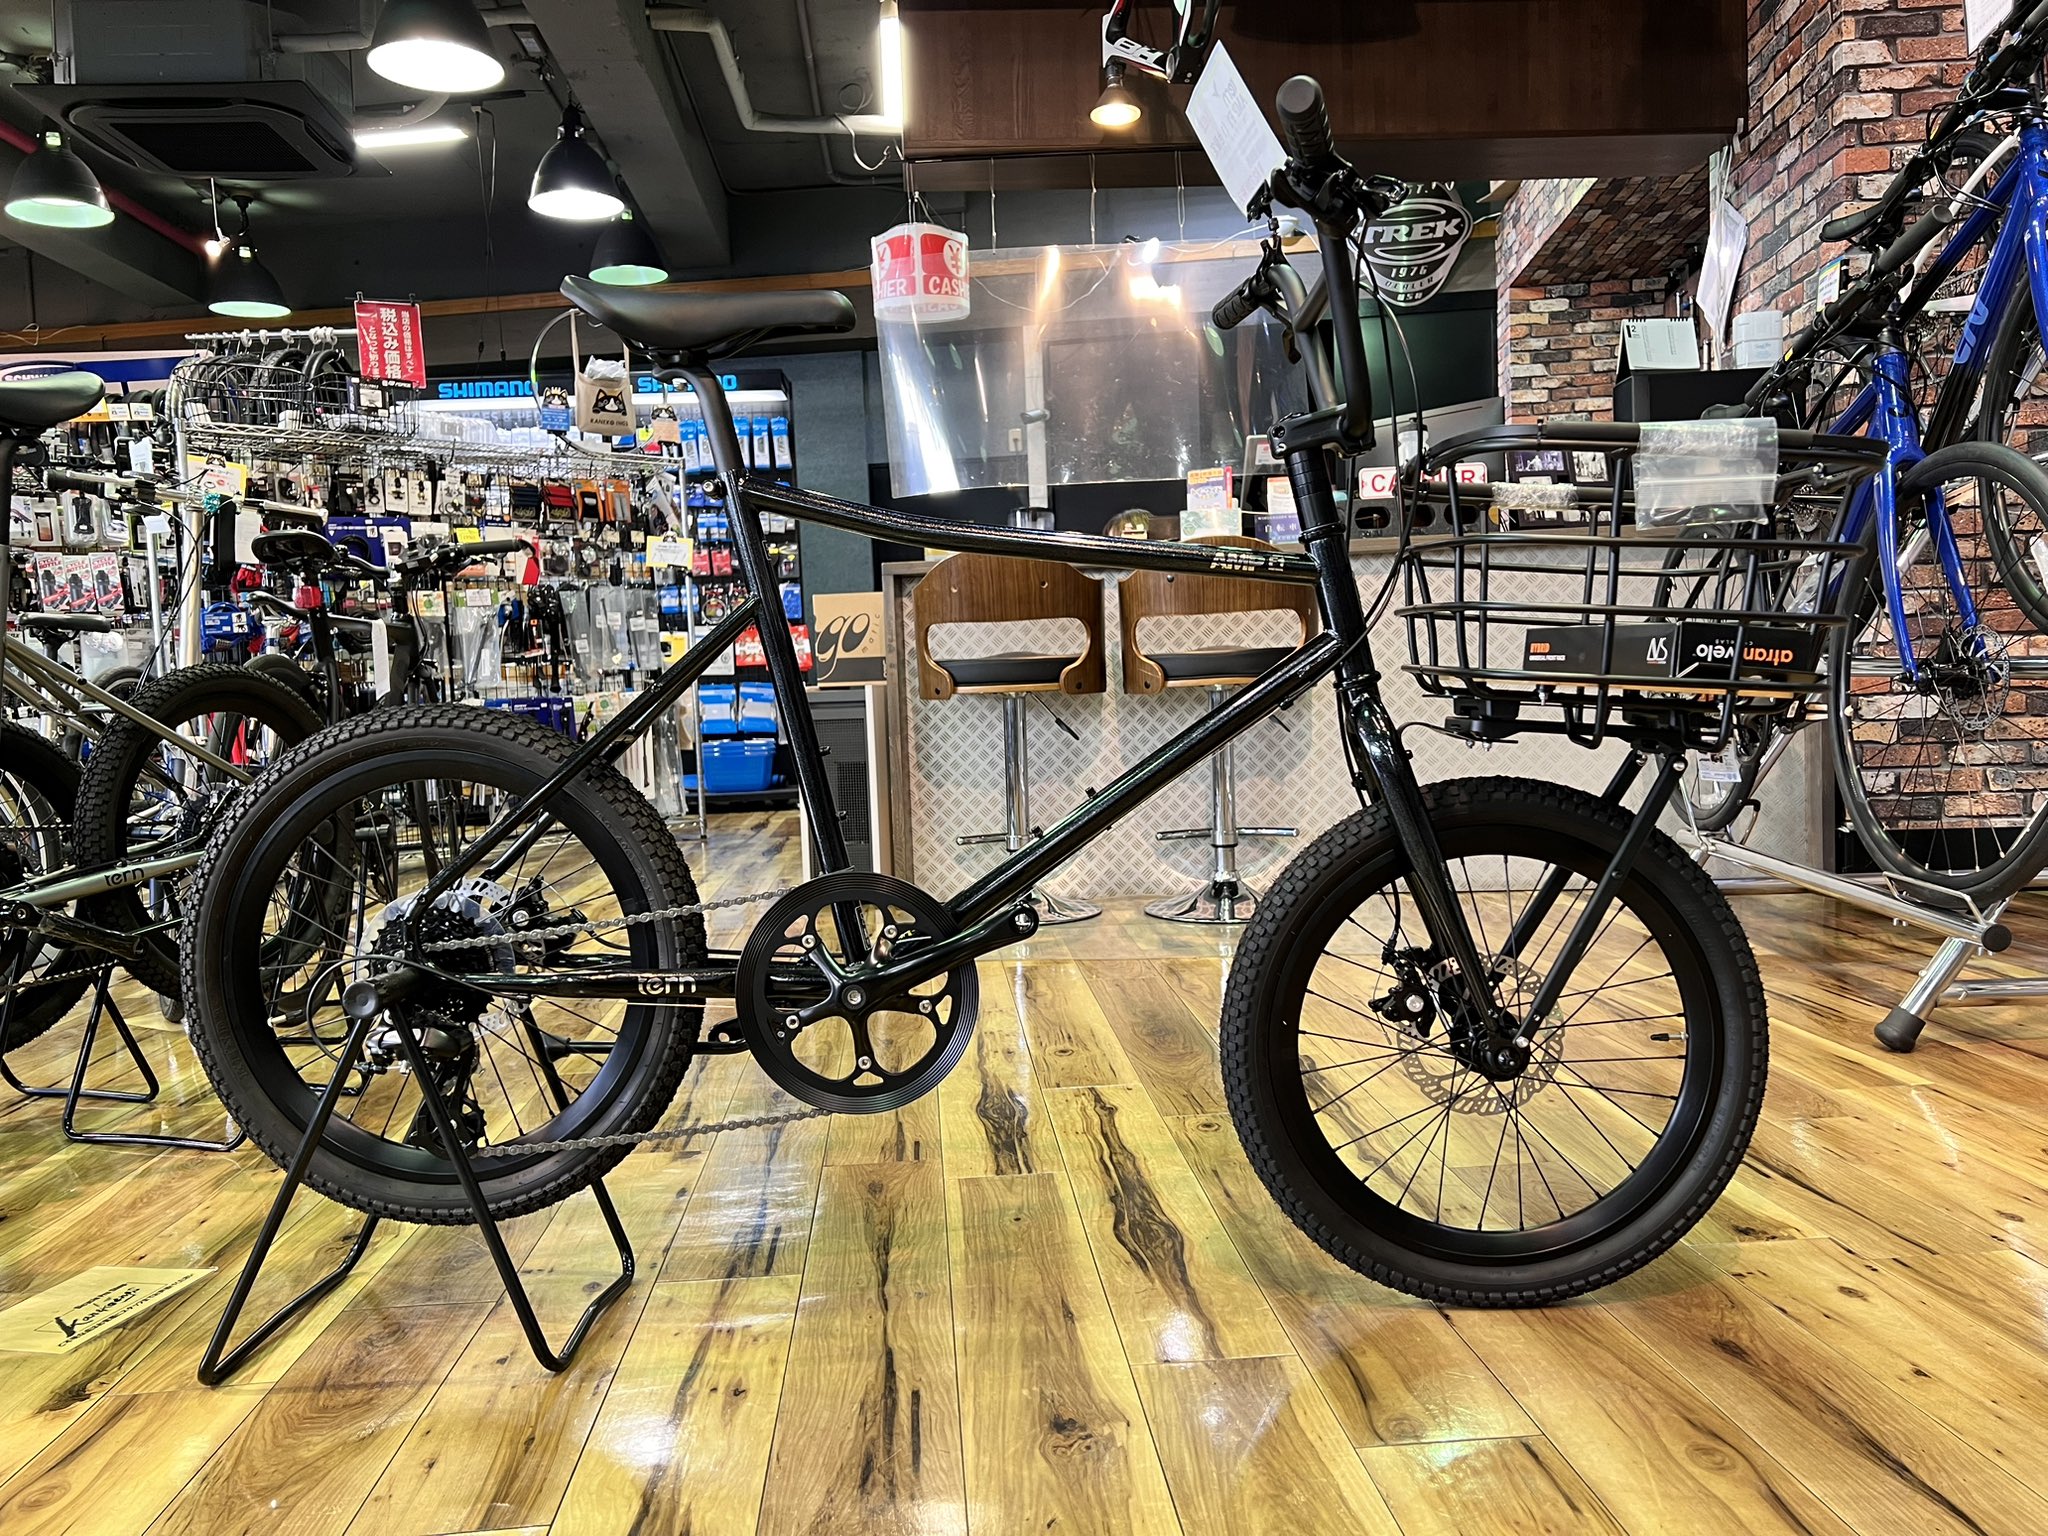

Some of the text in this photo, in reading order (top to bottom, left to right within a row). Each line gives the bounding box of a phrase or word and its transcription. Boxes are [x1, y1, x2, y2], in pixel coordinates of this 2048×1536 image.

[1364, 218, 1461, 244] TREK
[1391, 265, 1428, 278] 1976
[380, 307, 402, 380] 税込み価格
[1743, 647, 1793, 666] atran
[104, 867, 145, 887] tern
[638, 975, 697, 996] tern
